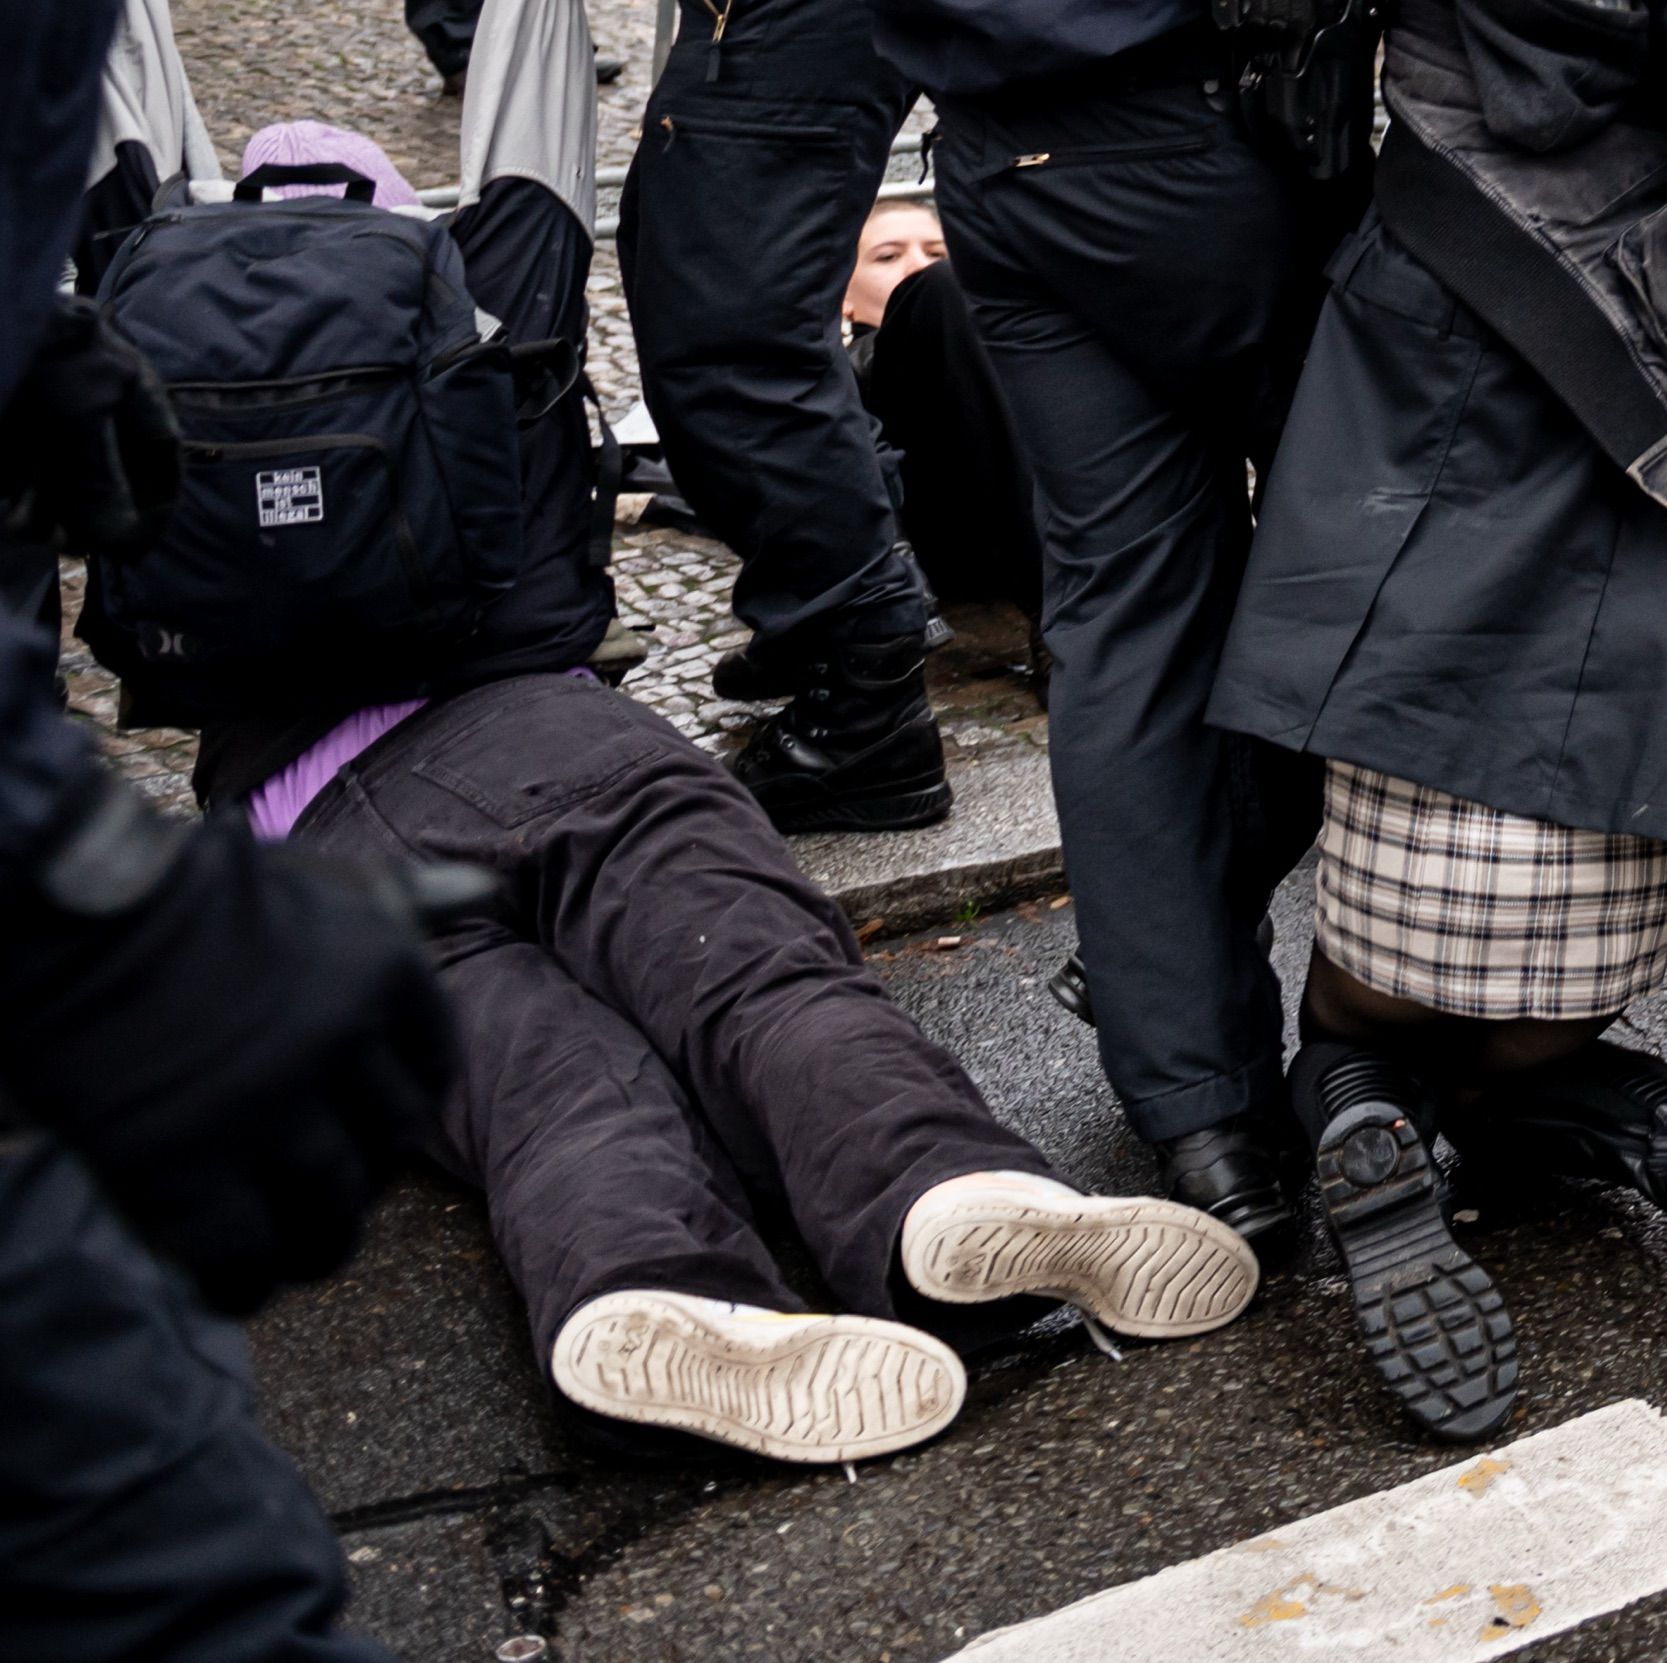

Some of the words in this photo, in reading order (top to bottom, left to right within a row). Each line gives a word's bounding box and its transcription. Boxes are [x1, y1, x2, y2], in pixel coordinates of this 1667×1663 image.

[274, 471, 303, 483] kein
[261, 480, 318, 497] mensch
[261, 506, 309, 525] illegal
